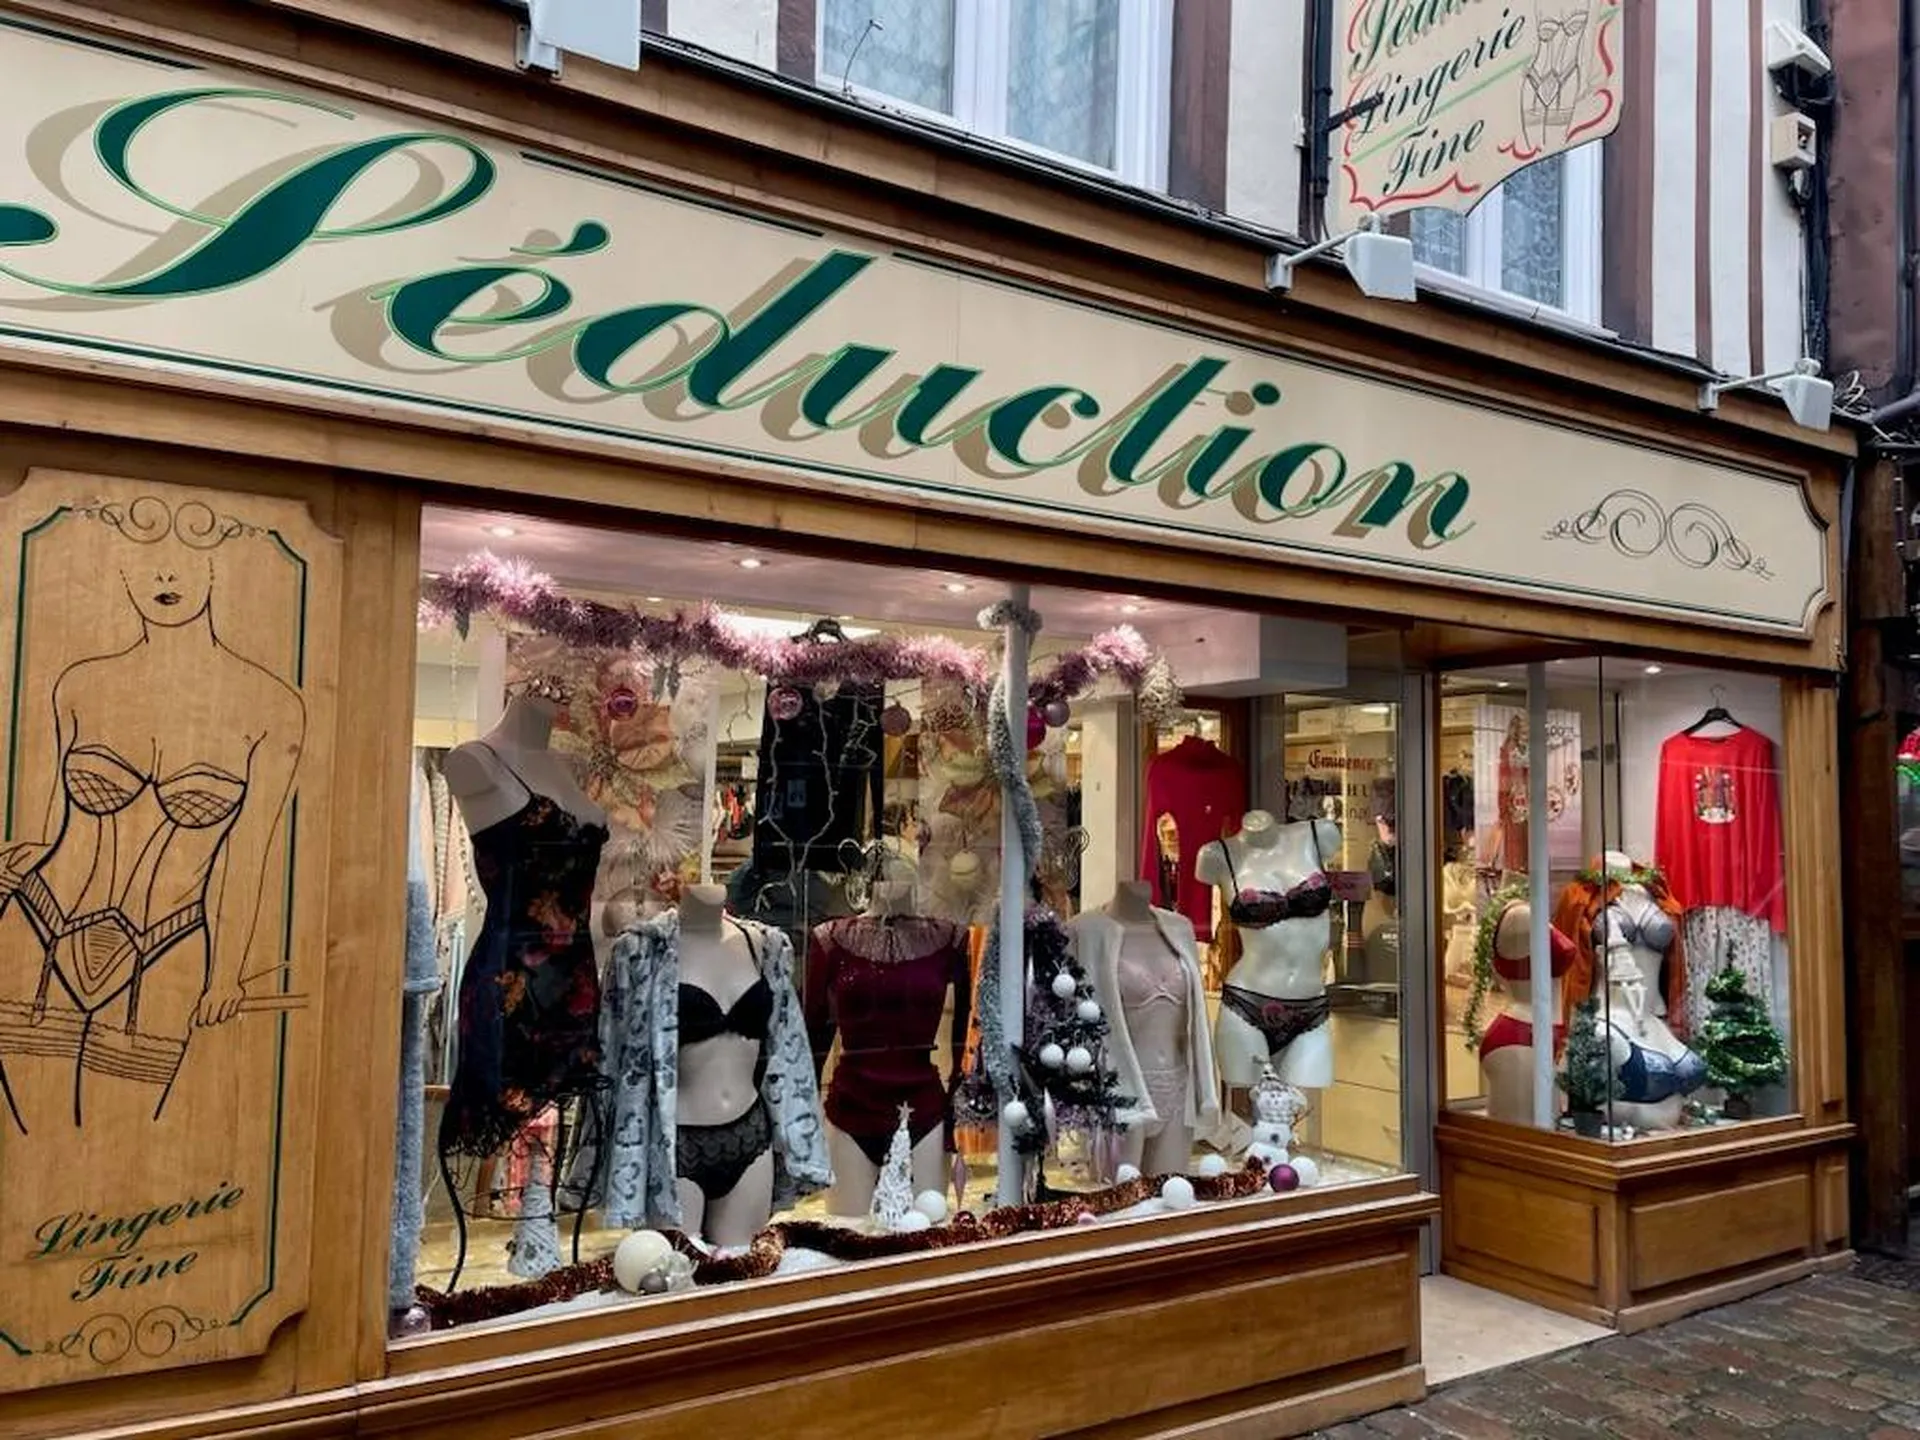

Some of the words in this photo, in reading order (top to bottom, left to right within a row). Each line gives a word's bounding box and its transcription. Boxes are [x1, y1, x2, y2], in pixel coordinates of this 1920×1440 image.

[1382, 119, 1485, 195] Fine
[0, 86, 1475, 542] Séduction
[25, 1181, 245, 1259] Lingerie
[70, 1251, 199, 1302] Fine
